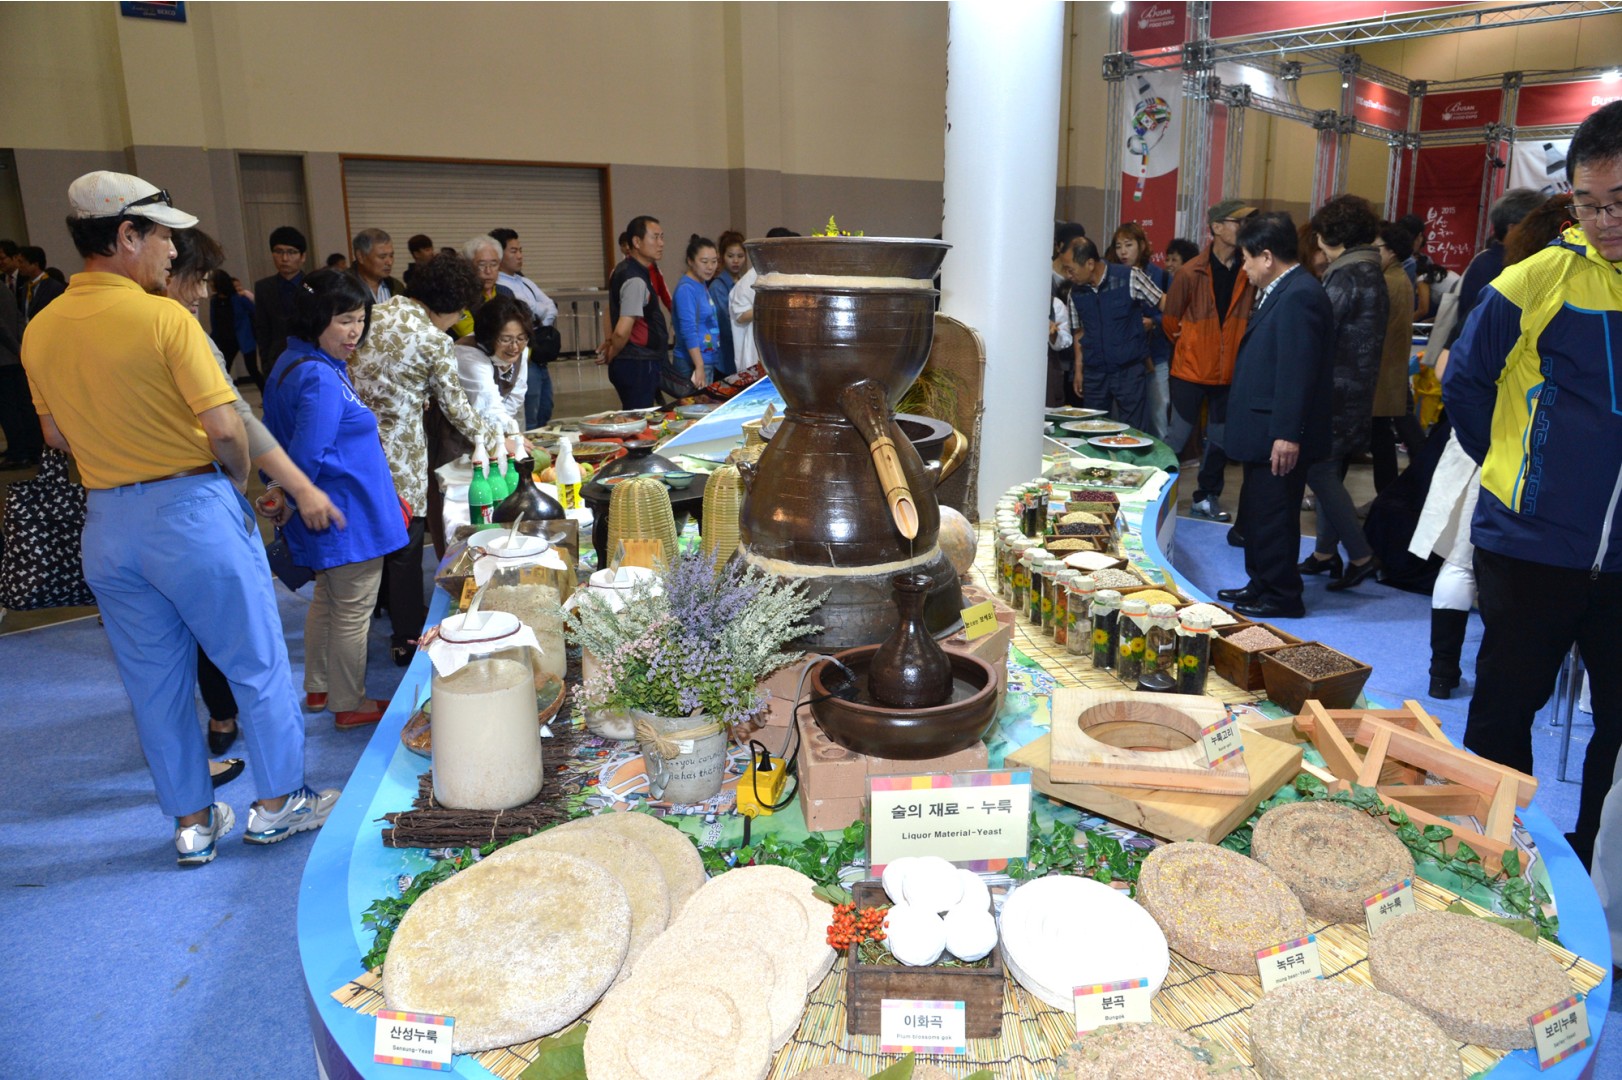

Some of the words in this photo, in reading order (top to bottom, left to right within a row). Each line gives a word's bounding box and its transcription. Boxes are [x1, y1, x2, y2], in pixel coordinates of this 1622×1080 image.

[1140, 4, 1172, 18] BUSAN
[1445, 101, 1476, 112] BUSAN
[1441, 206, 1456, 214] 2015
[1210, 727, 1234, 745] 누룩고리
[891, 804, 922, 819] 술의
[929, 802, 960, 817] 재료
[981, 799, 1012, 815] 누룩
[902, 832, 931, 840] Liquor
[934, 828, 1002, 838] Material-Yeast
[1276, 952, 1305, 971] 녹두곡
[1101, 995, 1125, 1010] 분곡
[904, 1014, 943, 1029] 이화곡
[1545, 1011, 1578, 1039] 보리누룩
[390, 1025, 438, 1044] 산성누룩
